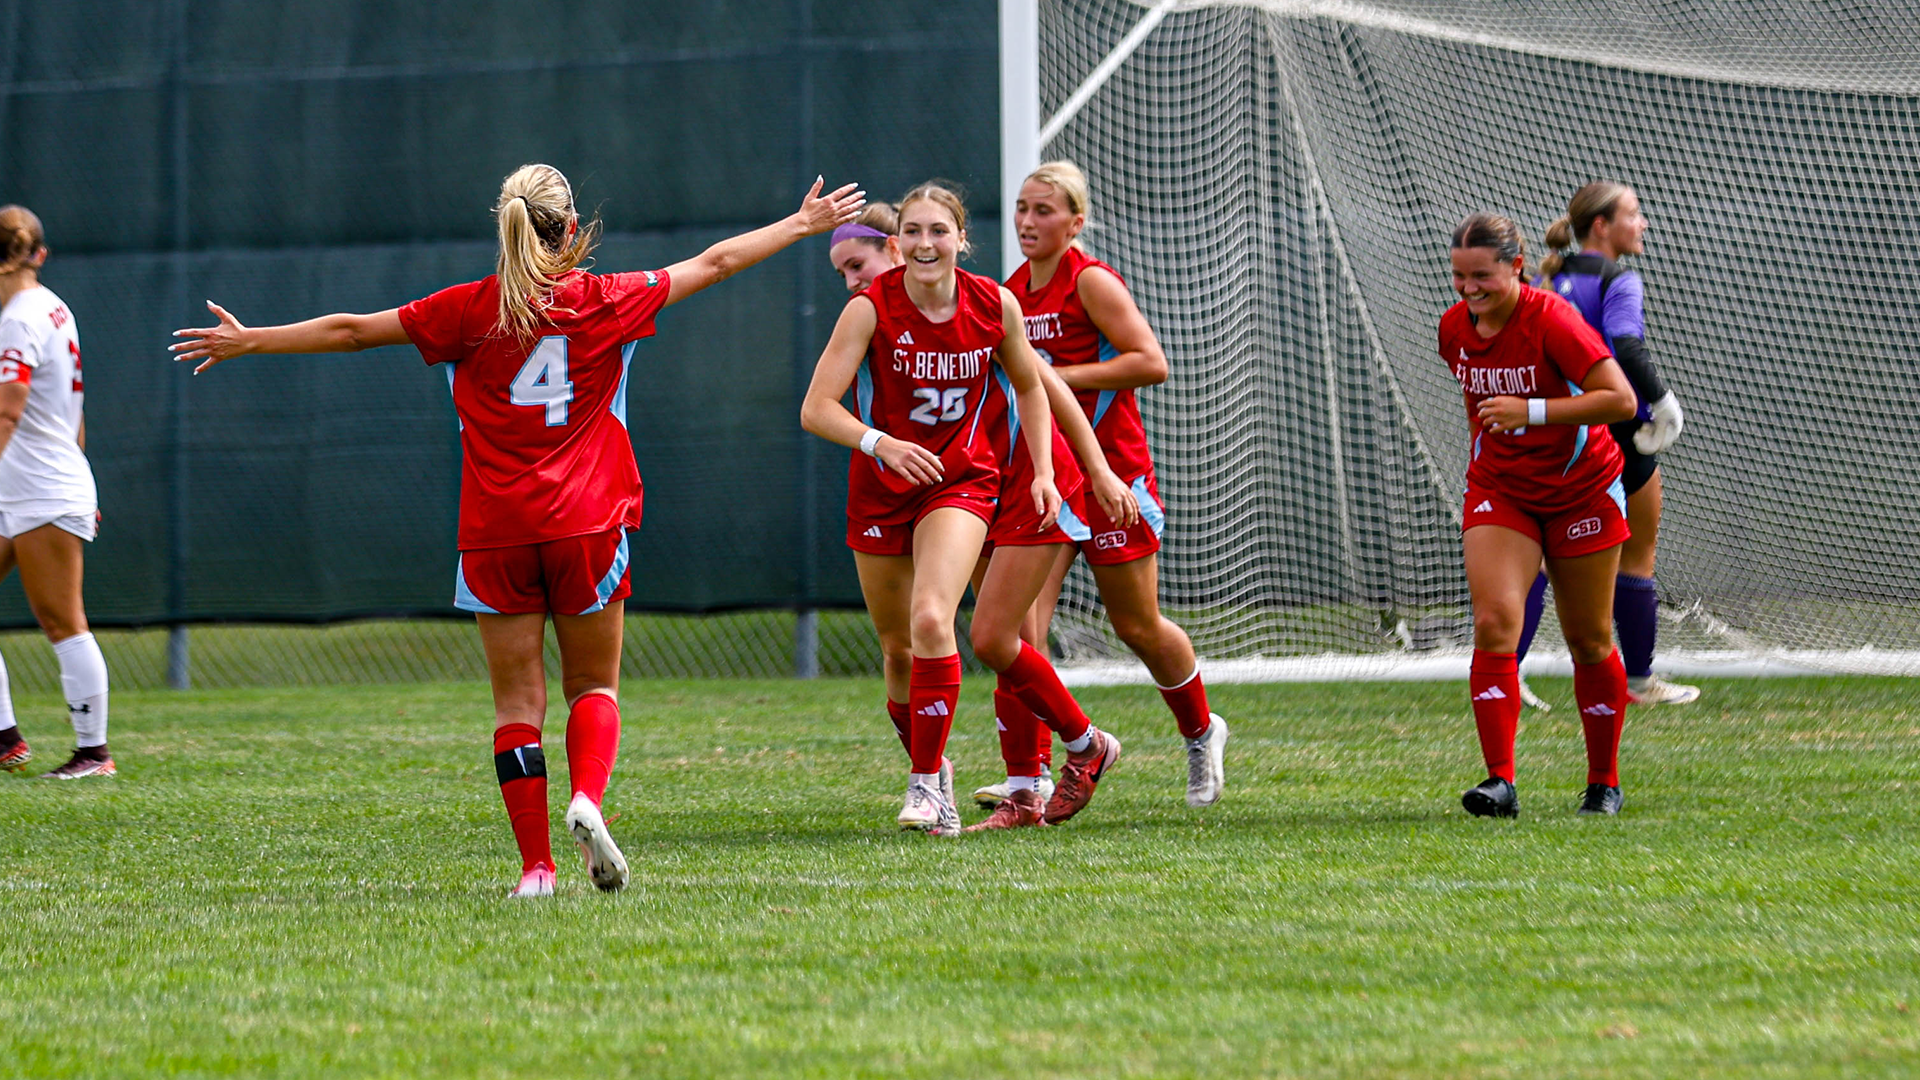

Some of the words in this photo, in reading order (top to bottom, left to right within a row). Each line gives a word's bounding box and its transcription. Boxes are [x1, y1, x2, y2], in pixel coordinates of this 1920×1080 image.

[509, 335, 575, 427] 4
[1094, 530, 1127, 550] CSB
[1567, 517, 1602, 540] CSB
